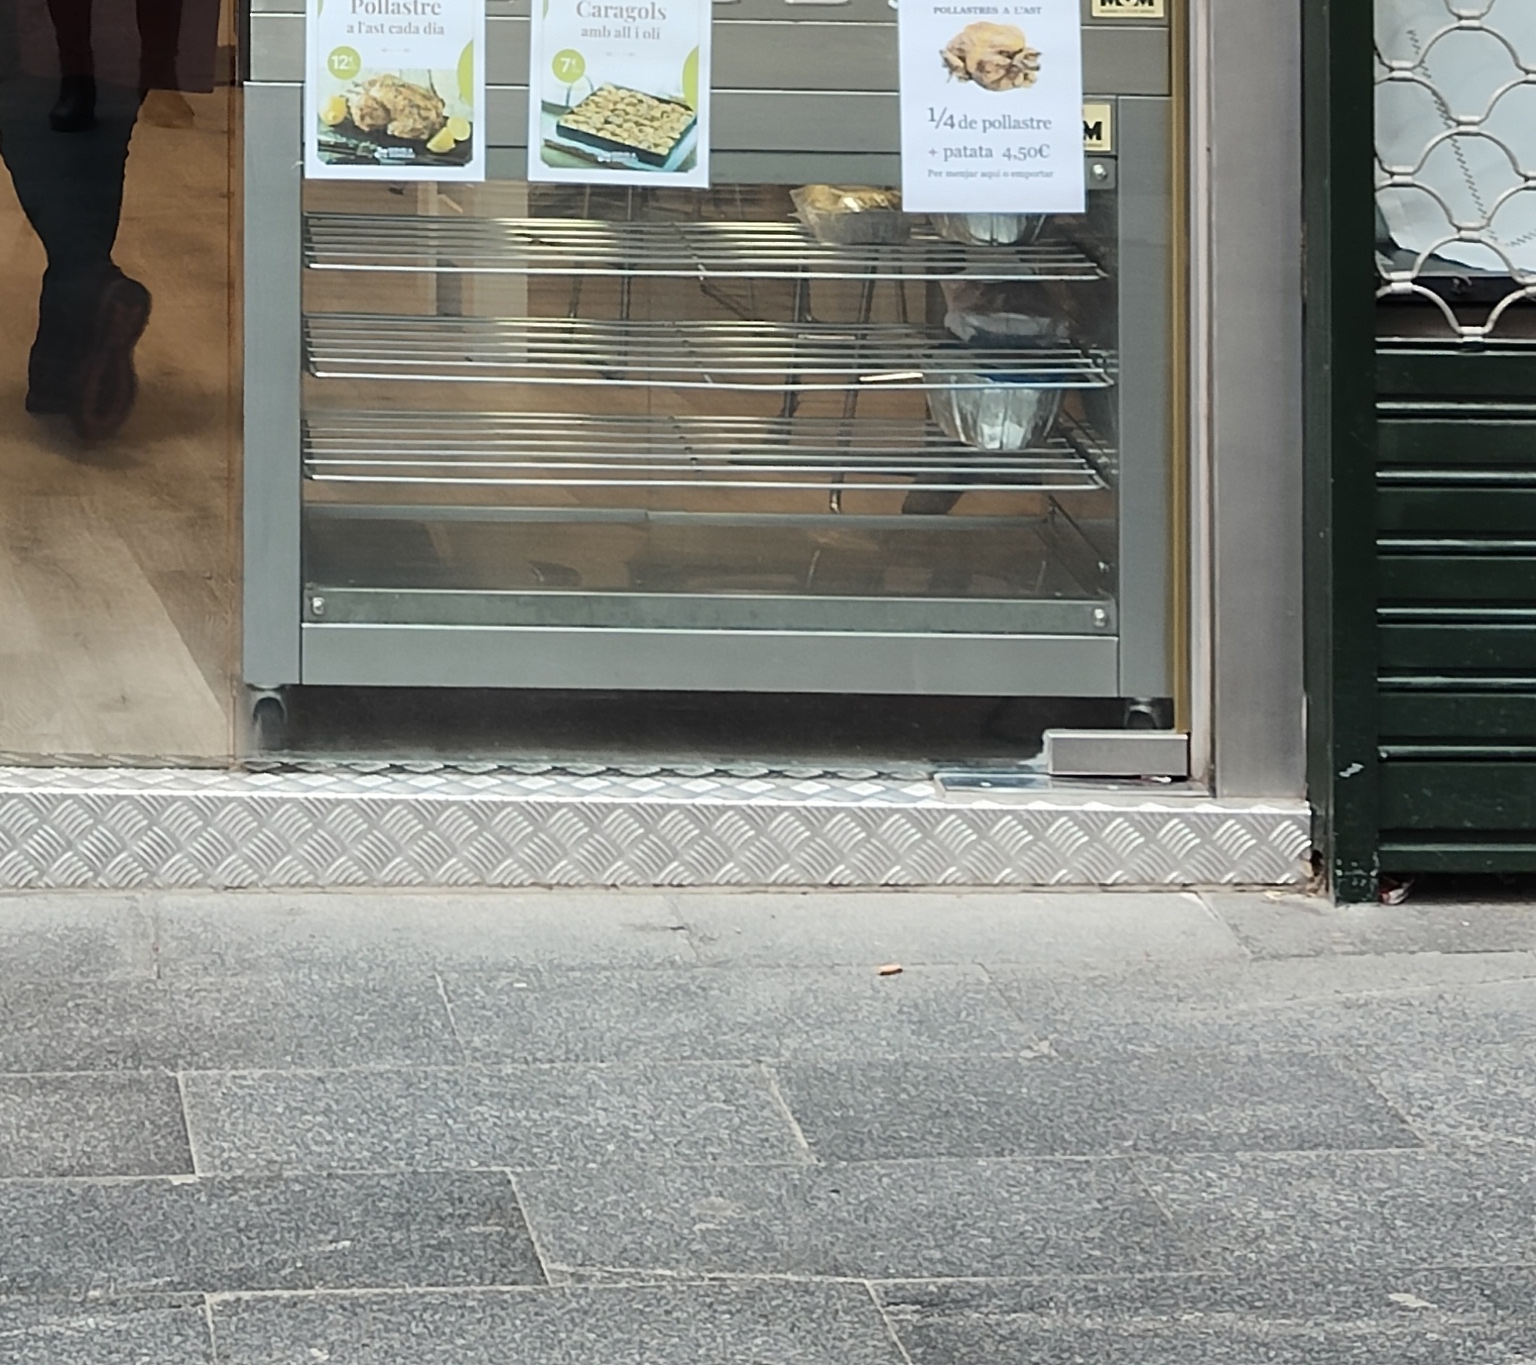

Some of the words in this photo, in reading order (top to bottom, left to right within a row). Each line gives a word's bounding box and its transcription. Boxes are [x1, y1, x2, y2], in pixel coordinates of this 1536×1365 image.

[423, 22, 445, 36] dia
[581, 26, 611, 39] amb
[613, 26, 632, 40] all
[958, 114, 978, 130] de
[981, 114, 1052, 134] pollastre
[943, 145, 994, 162] patata
